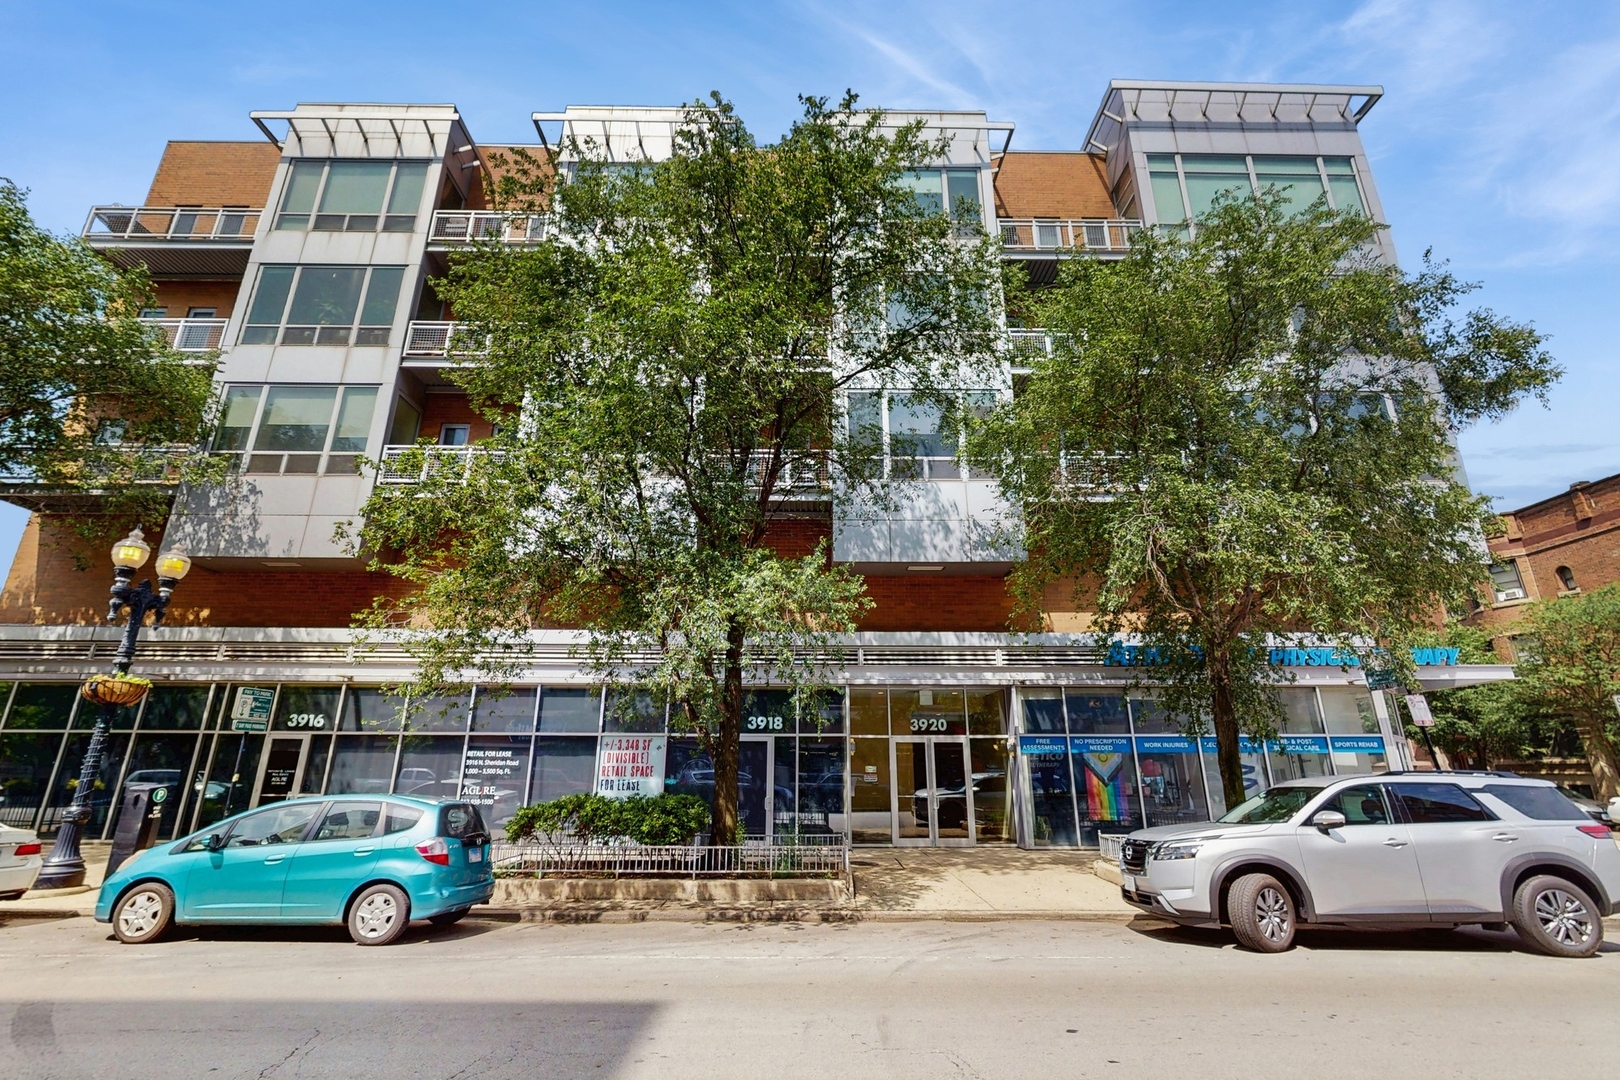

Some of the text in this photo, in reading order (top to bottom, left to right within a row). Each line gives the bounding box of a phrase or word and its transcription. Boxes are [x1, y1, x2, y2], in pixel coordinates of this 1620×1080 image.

[287, 713, 325, 728] 3916
[747, 716, 783, 730] 3918
[909, 718, 947, 731] 3920
[642, 739, 652, 751] SF
[467, 750, 485, 758] RETAIL
[485, 750, 496, 758] FOR
[601, 765, 655, 778] RETAIL SPACE
[600, 778, 640, 791] FOR LEASE
